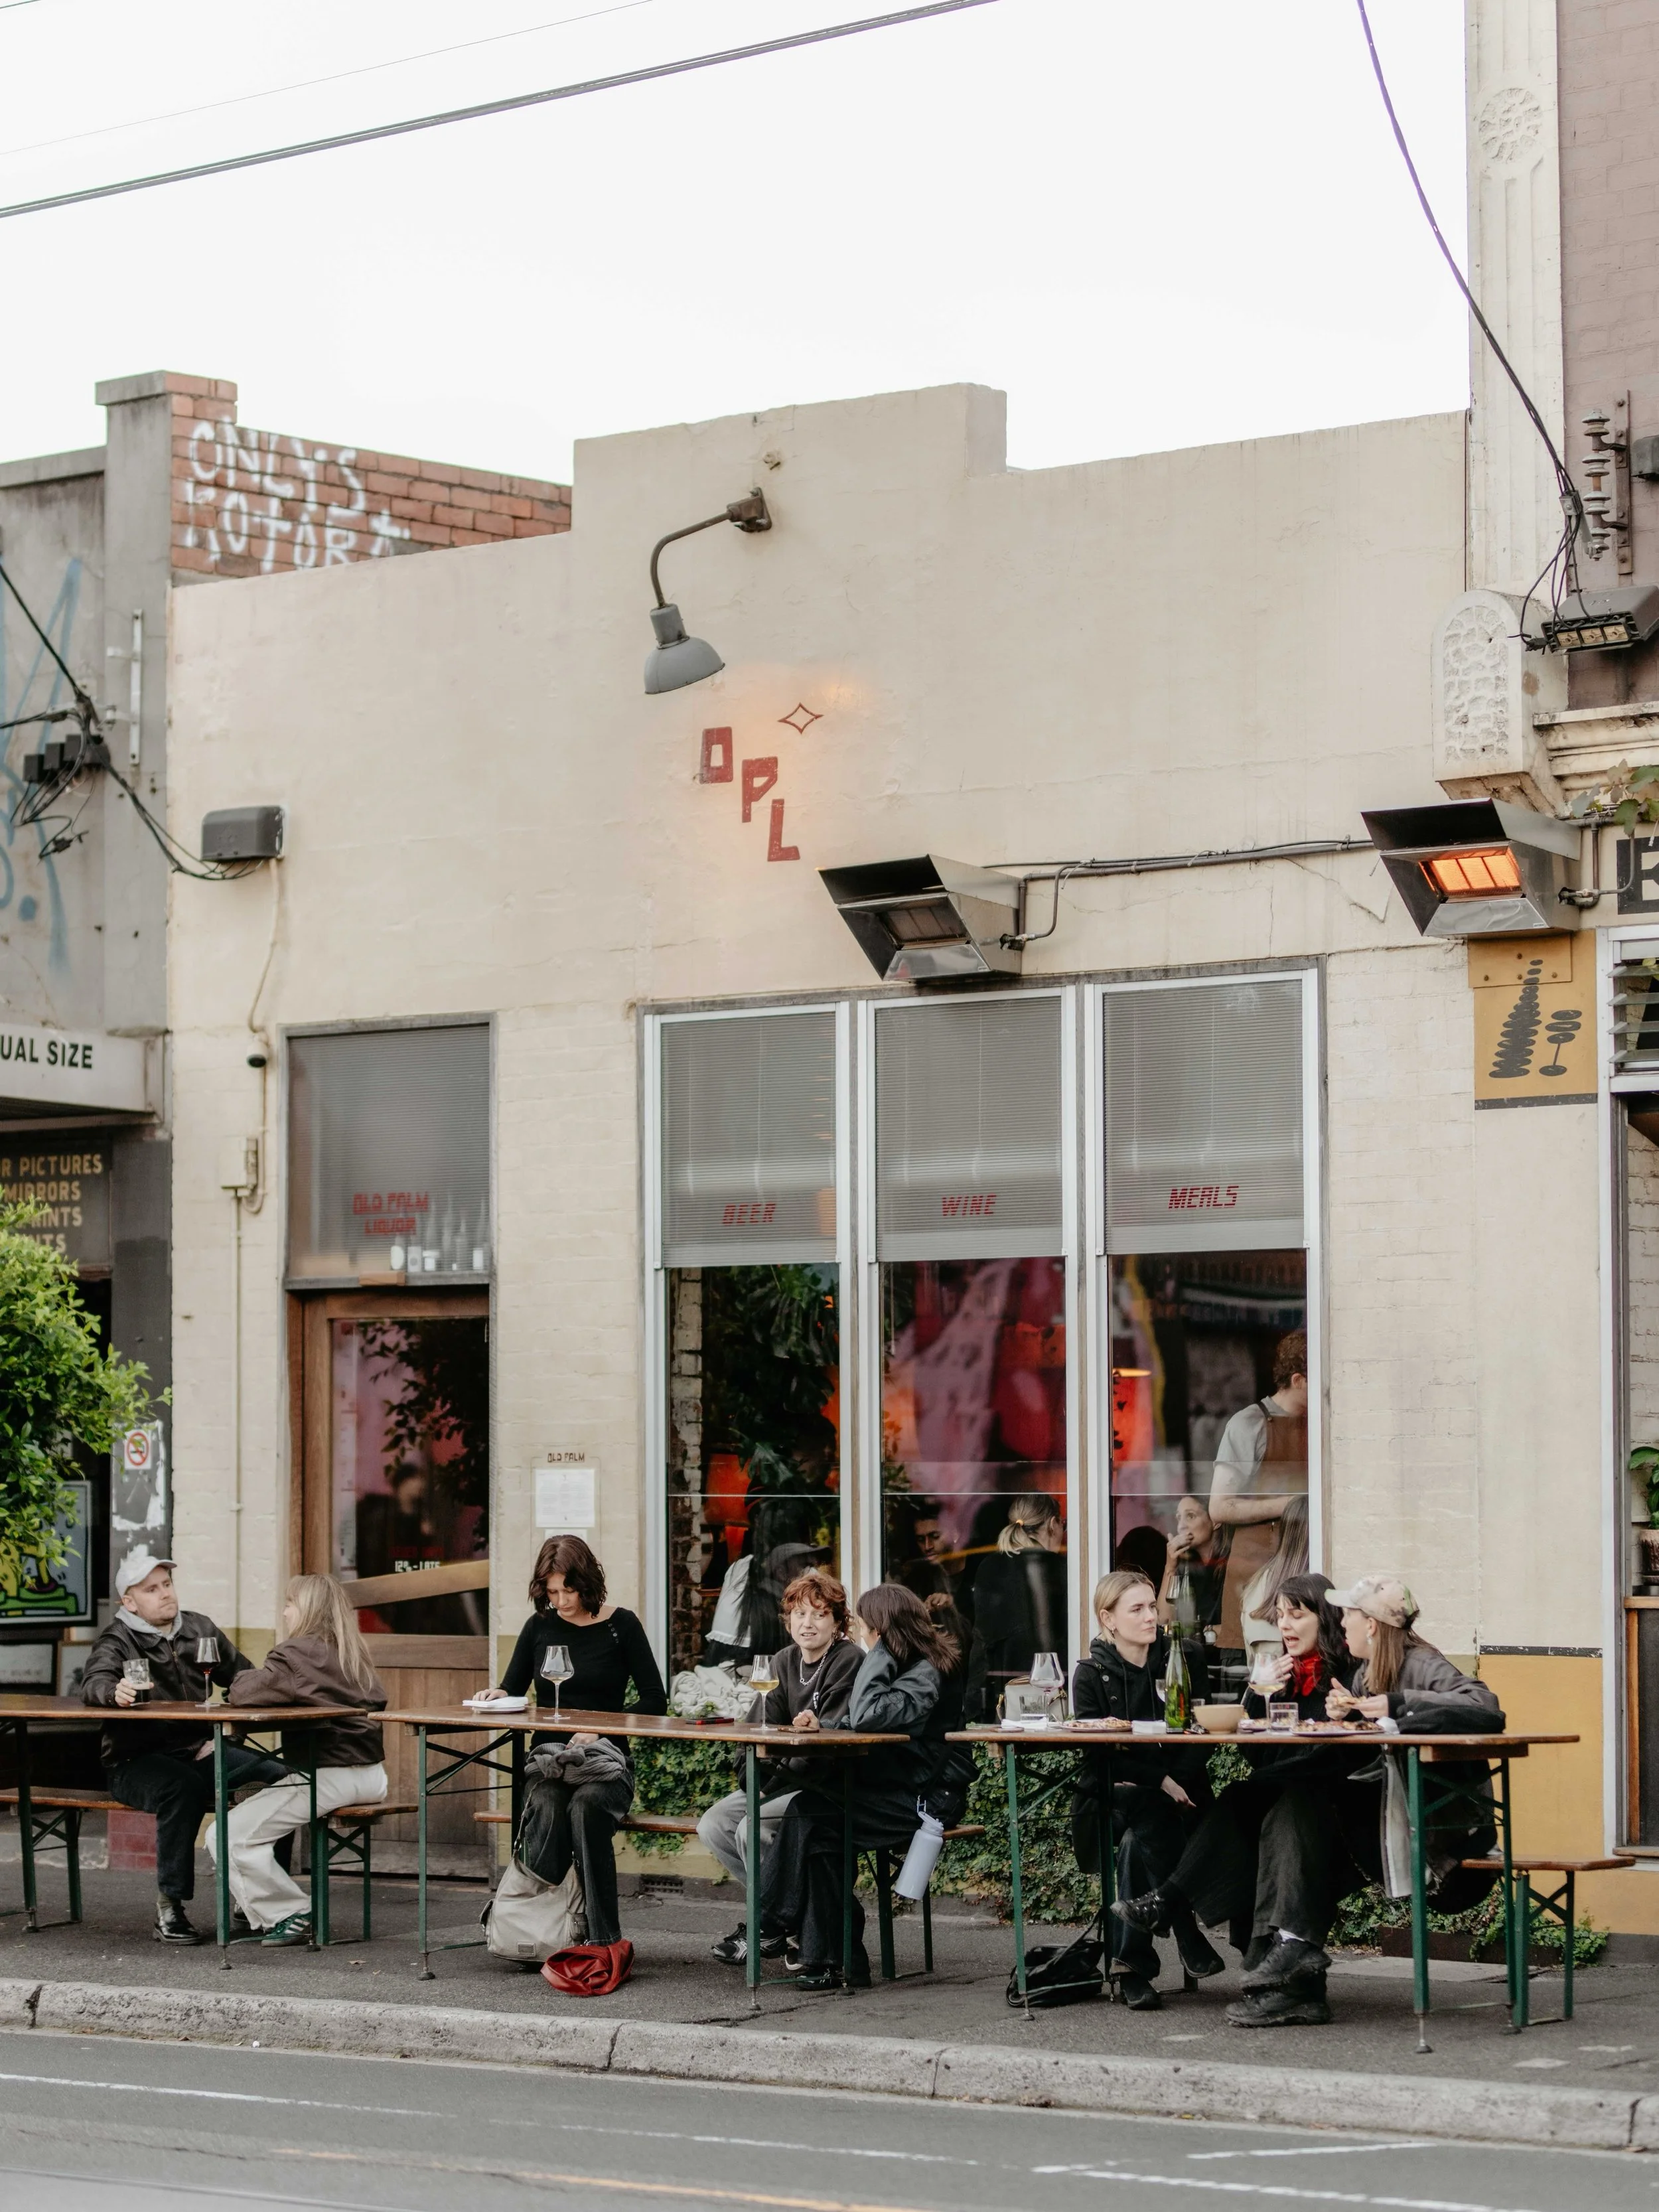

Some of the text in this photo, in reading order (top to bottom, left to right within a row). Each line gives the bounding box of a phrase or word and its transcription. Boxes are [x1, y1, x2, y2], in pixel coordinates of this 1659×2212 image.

[699, 726, 800, 862] OPL
[0, 1034, 93, 1069] UAL SIZE
[19, 1154, 103, 1177] PICTURES
[3, 1180, 81, 1203] MIRRORS
[1169, 1186, 1239, 1209] MEALS
[18, 1207, 82, 1228] RINTS
[722, 1203, 776, 1225] BEER
[942, 1195, 997, 1217] WINE
[547, 1453, 585, 1463] OLD PALM
